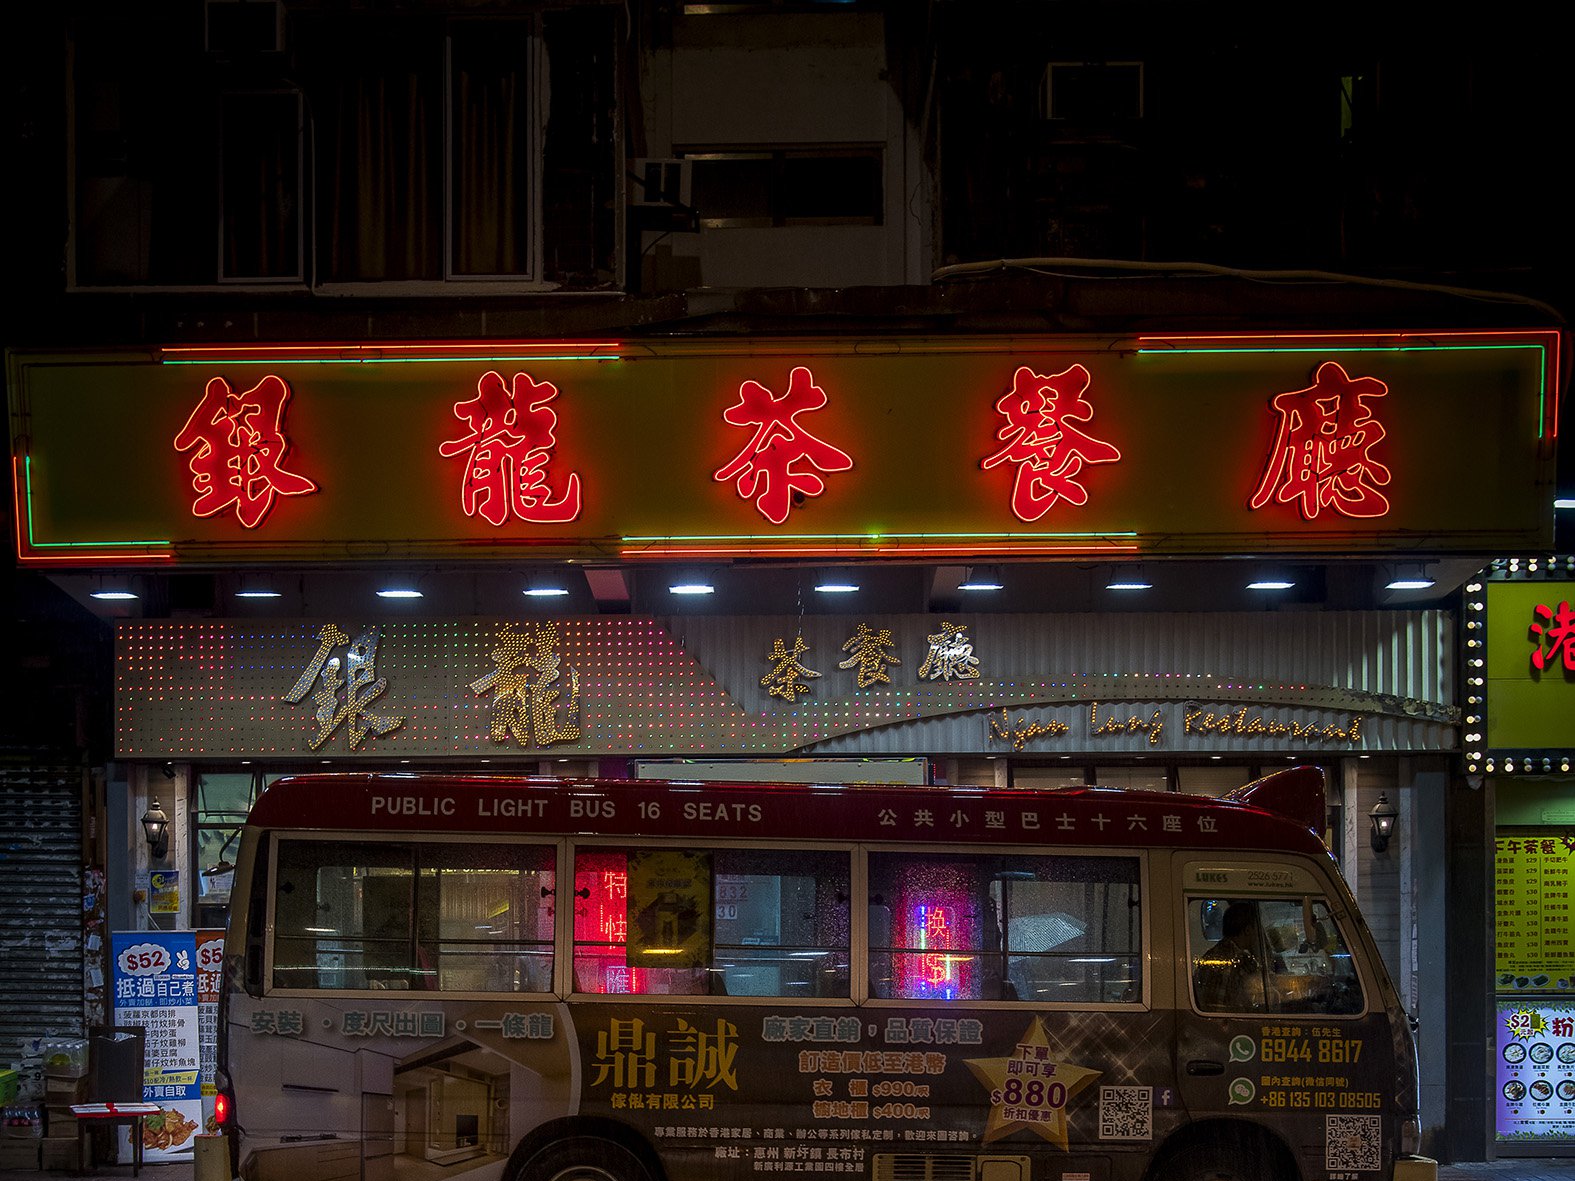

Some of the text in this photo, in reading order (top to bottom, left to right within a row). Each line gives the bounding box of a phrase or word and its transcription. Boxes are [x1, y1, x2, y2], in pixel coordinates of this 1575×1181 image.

[173, 360, 1392, 528] 銀龍茶餐廳
[284, 621, 981, 752] 銀龍 茶餐廳
[1091, 702, 1163, 744] Lung
[1183, 701, 1363, 745] Restaurant
[371, 797, 763, 822] PUBLIC LIGHT BUS 16 SEATS
[878, 809, 1219, 833] 公共小型巴士十六座位
[127, 950, 165, 972] $52
[117, 978, 195, 999] 抵過自己煮
[590, 1018, 739, 1091] 鼎誠
[799, 1051, 947, 1074] 訂造價低至港幣
[1261, 1039, 1363, 1064] 6944 8617
[1007, 1060, 1058, 1079] 即可享
[144, 1085, 187, 1098] 外賣自取
[990, 1079, 1067, 1109] $880
[1289, 1091, 1311, 1108] 135
[1315, 1092, 1335, 1109] 103
[1338, 1093, 1381, 1109] 08505
[1003, 1107, 1053, 1122] 折扣優惠
